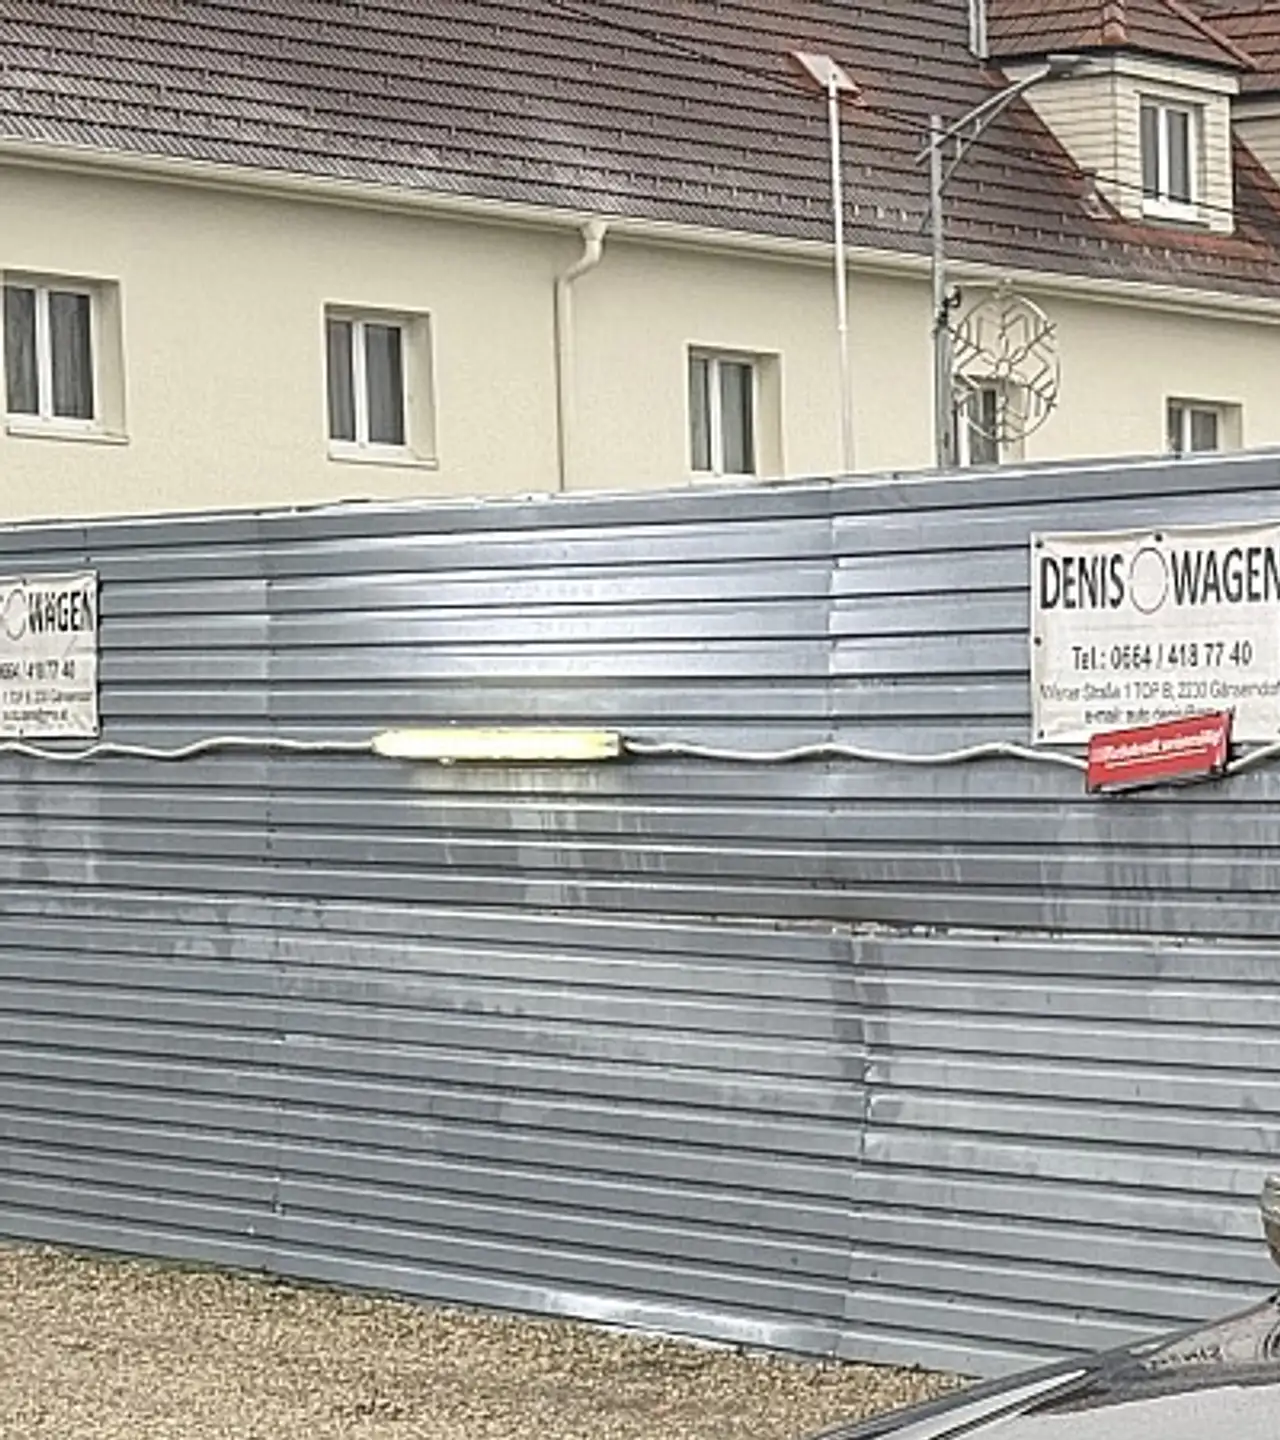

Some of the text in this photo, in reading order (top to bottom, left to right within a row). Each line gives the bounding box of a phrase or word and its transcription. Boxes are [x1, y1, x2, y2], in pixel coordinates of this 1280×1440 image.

[1040, 554, 1125, 610] DENIS
[1203, 643, 1225, 667] 77
[1228, 641, 1253, 667] 40
